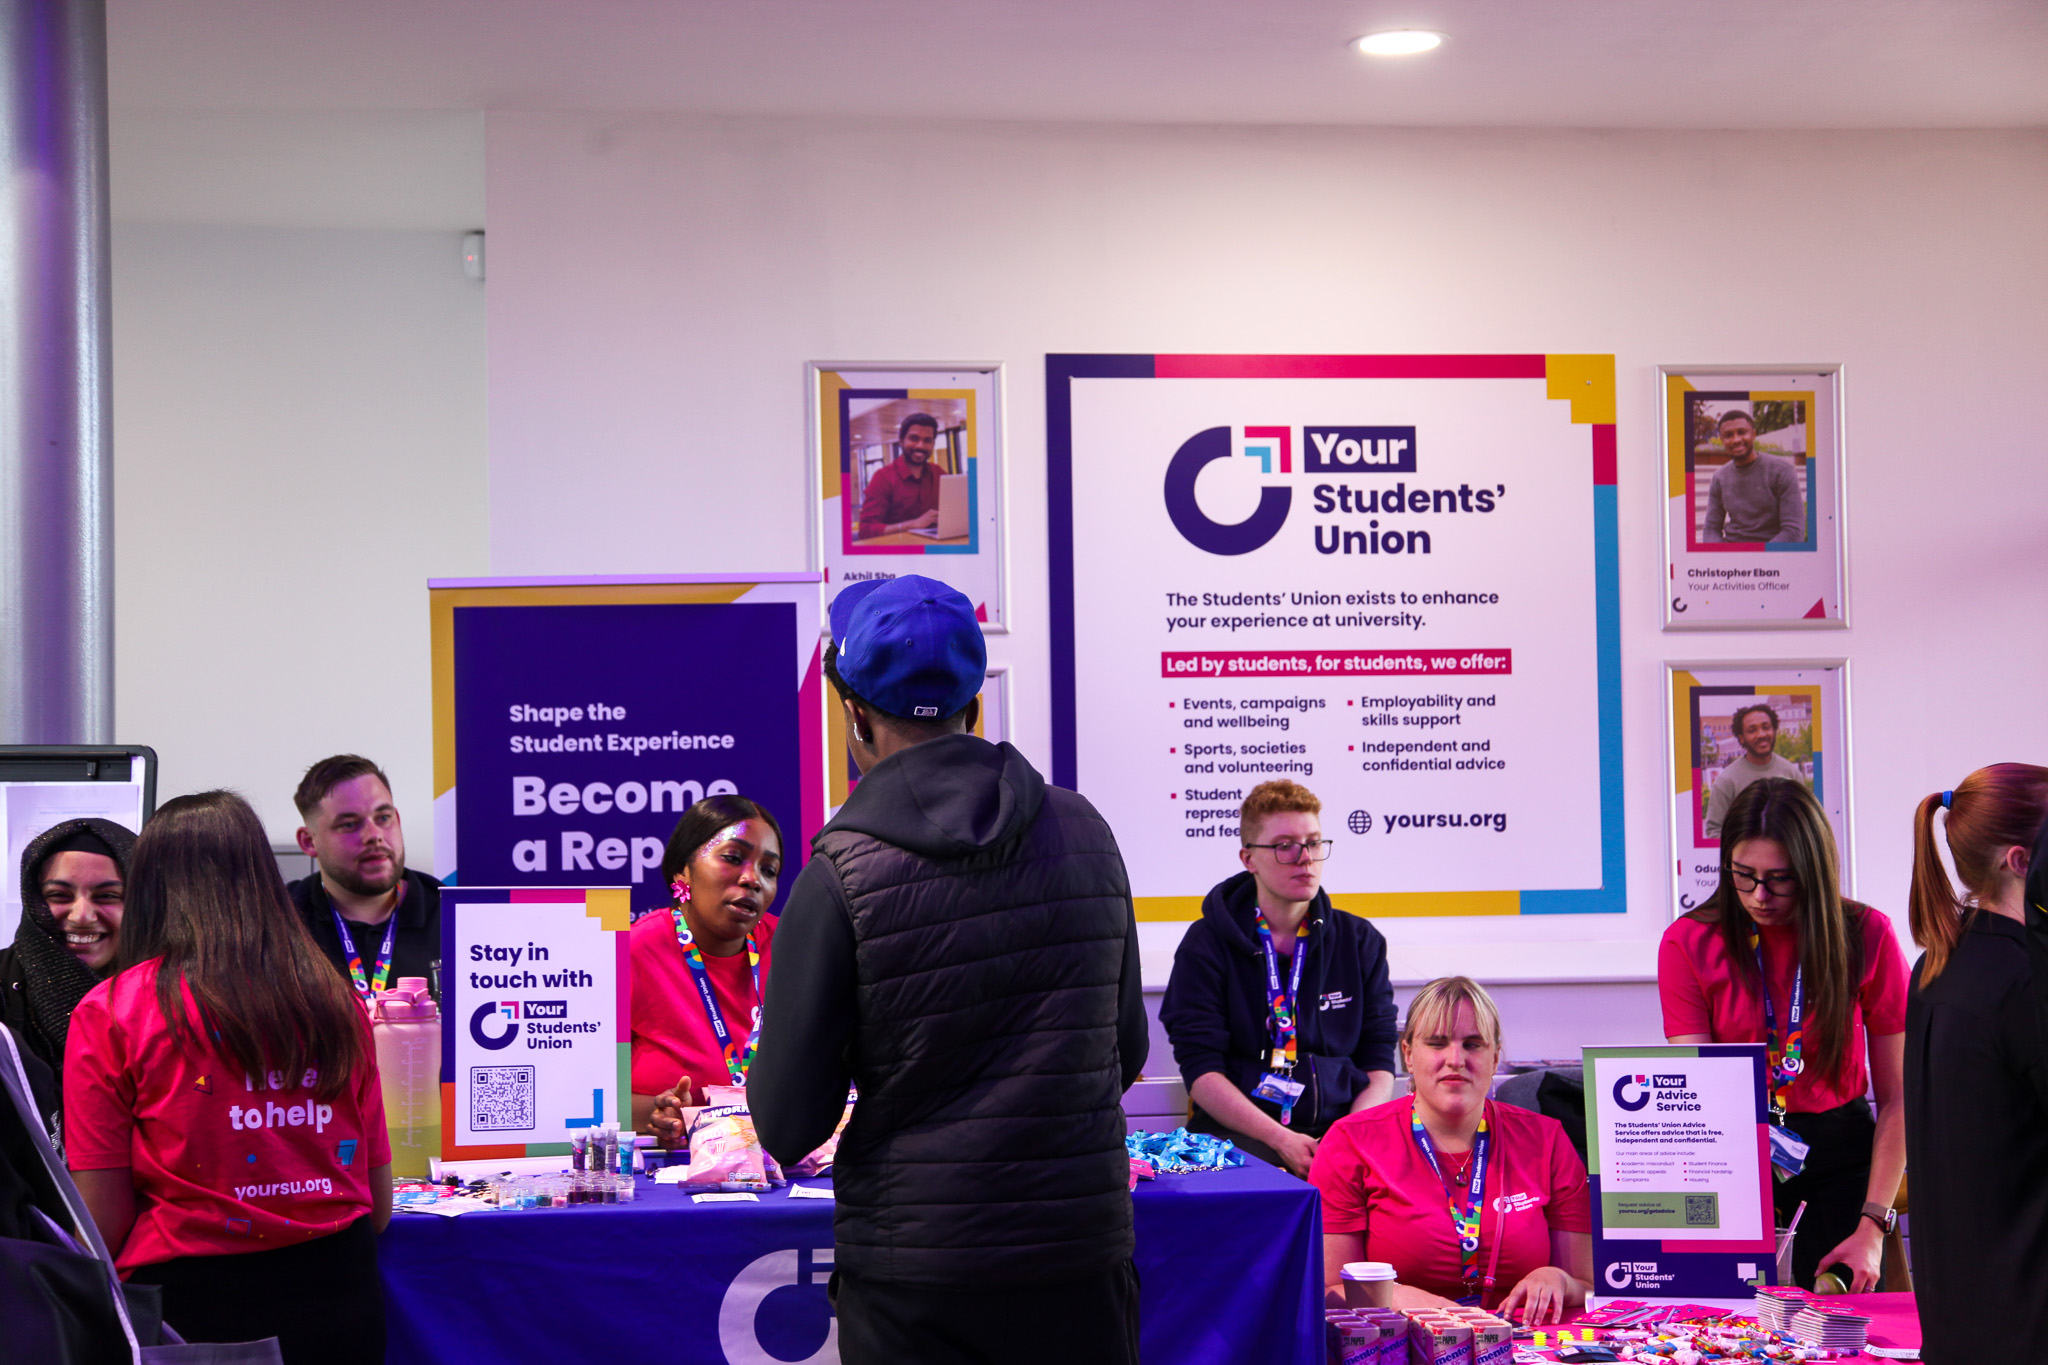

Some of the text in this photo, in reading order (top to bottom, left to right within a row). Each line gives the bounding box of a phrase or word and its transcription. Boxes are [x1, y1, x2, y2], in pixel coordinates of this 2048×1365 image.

[1311, 433, 1407, 464] Your
[1314, 483, 1505, 513] Students’
[1315, 520, 1431, 554] Union
[844, 572, 896, 580] Akhil Sha
[1688, 568, 1780, 579] Christopher Eban
[1688, 582, 1790, 591] Your Activities Officer
[1166, 590, 1499, 606] The Students’ Union exists to enhance
[1167, 612, 1425, 632] your experience at university.
[1167, 653, 1506, 675] Led by students, for students, we offer:
[1184, 696, 1325, 712] Events, campaigns
[1362, 694, 1495, 711] Employability and
[510, 703, 626, 725] Shape the
[1362, 713, 1460, 729] skills support
[1184, 715, 1289, 731] and wellbeing
[510, 731, 734, 755] Student Experience
[1185, 741, 1306, 759] Sports, societies
[1363, 740, 1490, 756] Independent and
[1185, 760, 1313, 776] and volunteering
[1363, 757, 1505, 771] confidential advice
[1185, 789, 1242, 800] Student
[1185, 809, 1241, 823] represe
[1384, 811, 1506, 834] yoursu.org
[1185, 825, 1241, 837] and fee
[513, 840, 547, 873] a
[1695, 865, 1720, 873] Odu
[470, 942, 548, 965] Stay in
[470, 969, 592, 988] touch with
[527, 1004, 564, 1015] Your
[527, 1020, 600, 1034] Students’
[528, 1036, 572, 1049] Union
[1655, 1077, 1684, 1086] Your
[1656, 1090, 1697, 1099] Advice
[1657, 1101, 1701, 1111] Service
[229, 1099, 332, 1133] to help
[1615, 1137, 1659, 1145] independent
[1708, 1129, 1725, 1137] free,
[234, 1178, 332, 1201] yoursu.org
[1442, 1336, 1457, 1344] PAPER
[1484, 1334, 1499, 1343] PAPER
[1344, 1344, 1379, 1365] mentos
[1435, 1343, 1471, 1365] mentos
[1477, 1341, 1513, 1364] mentos
